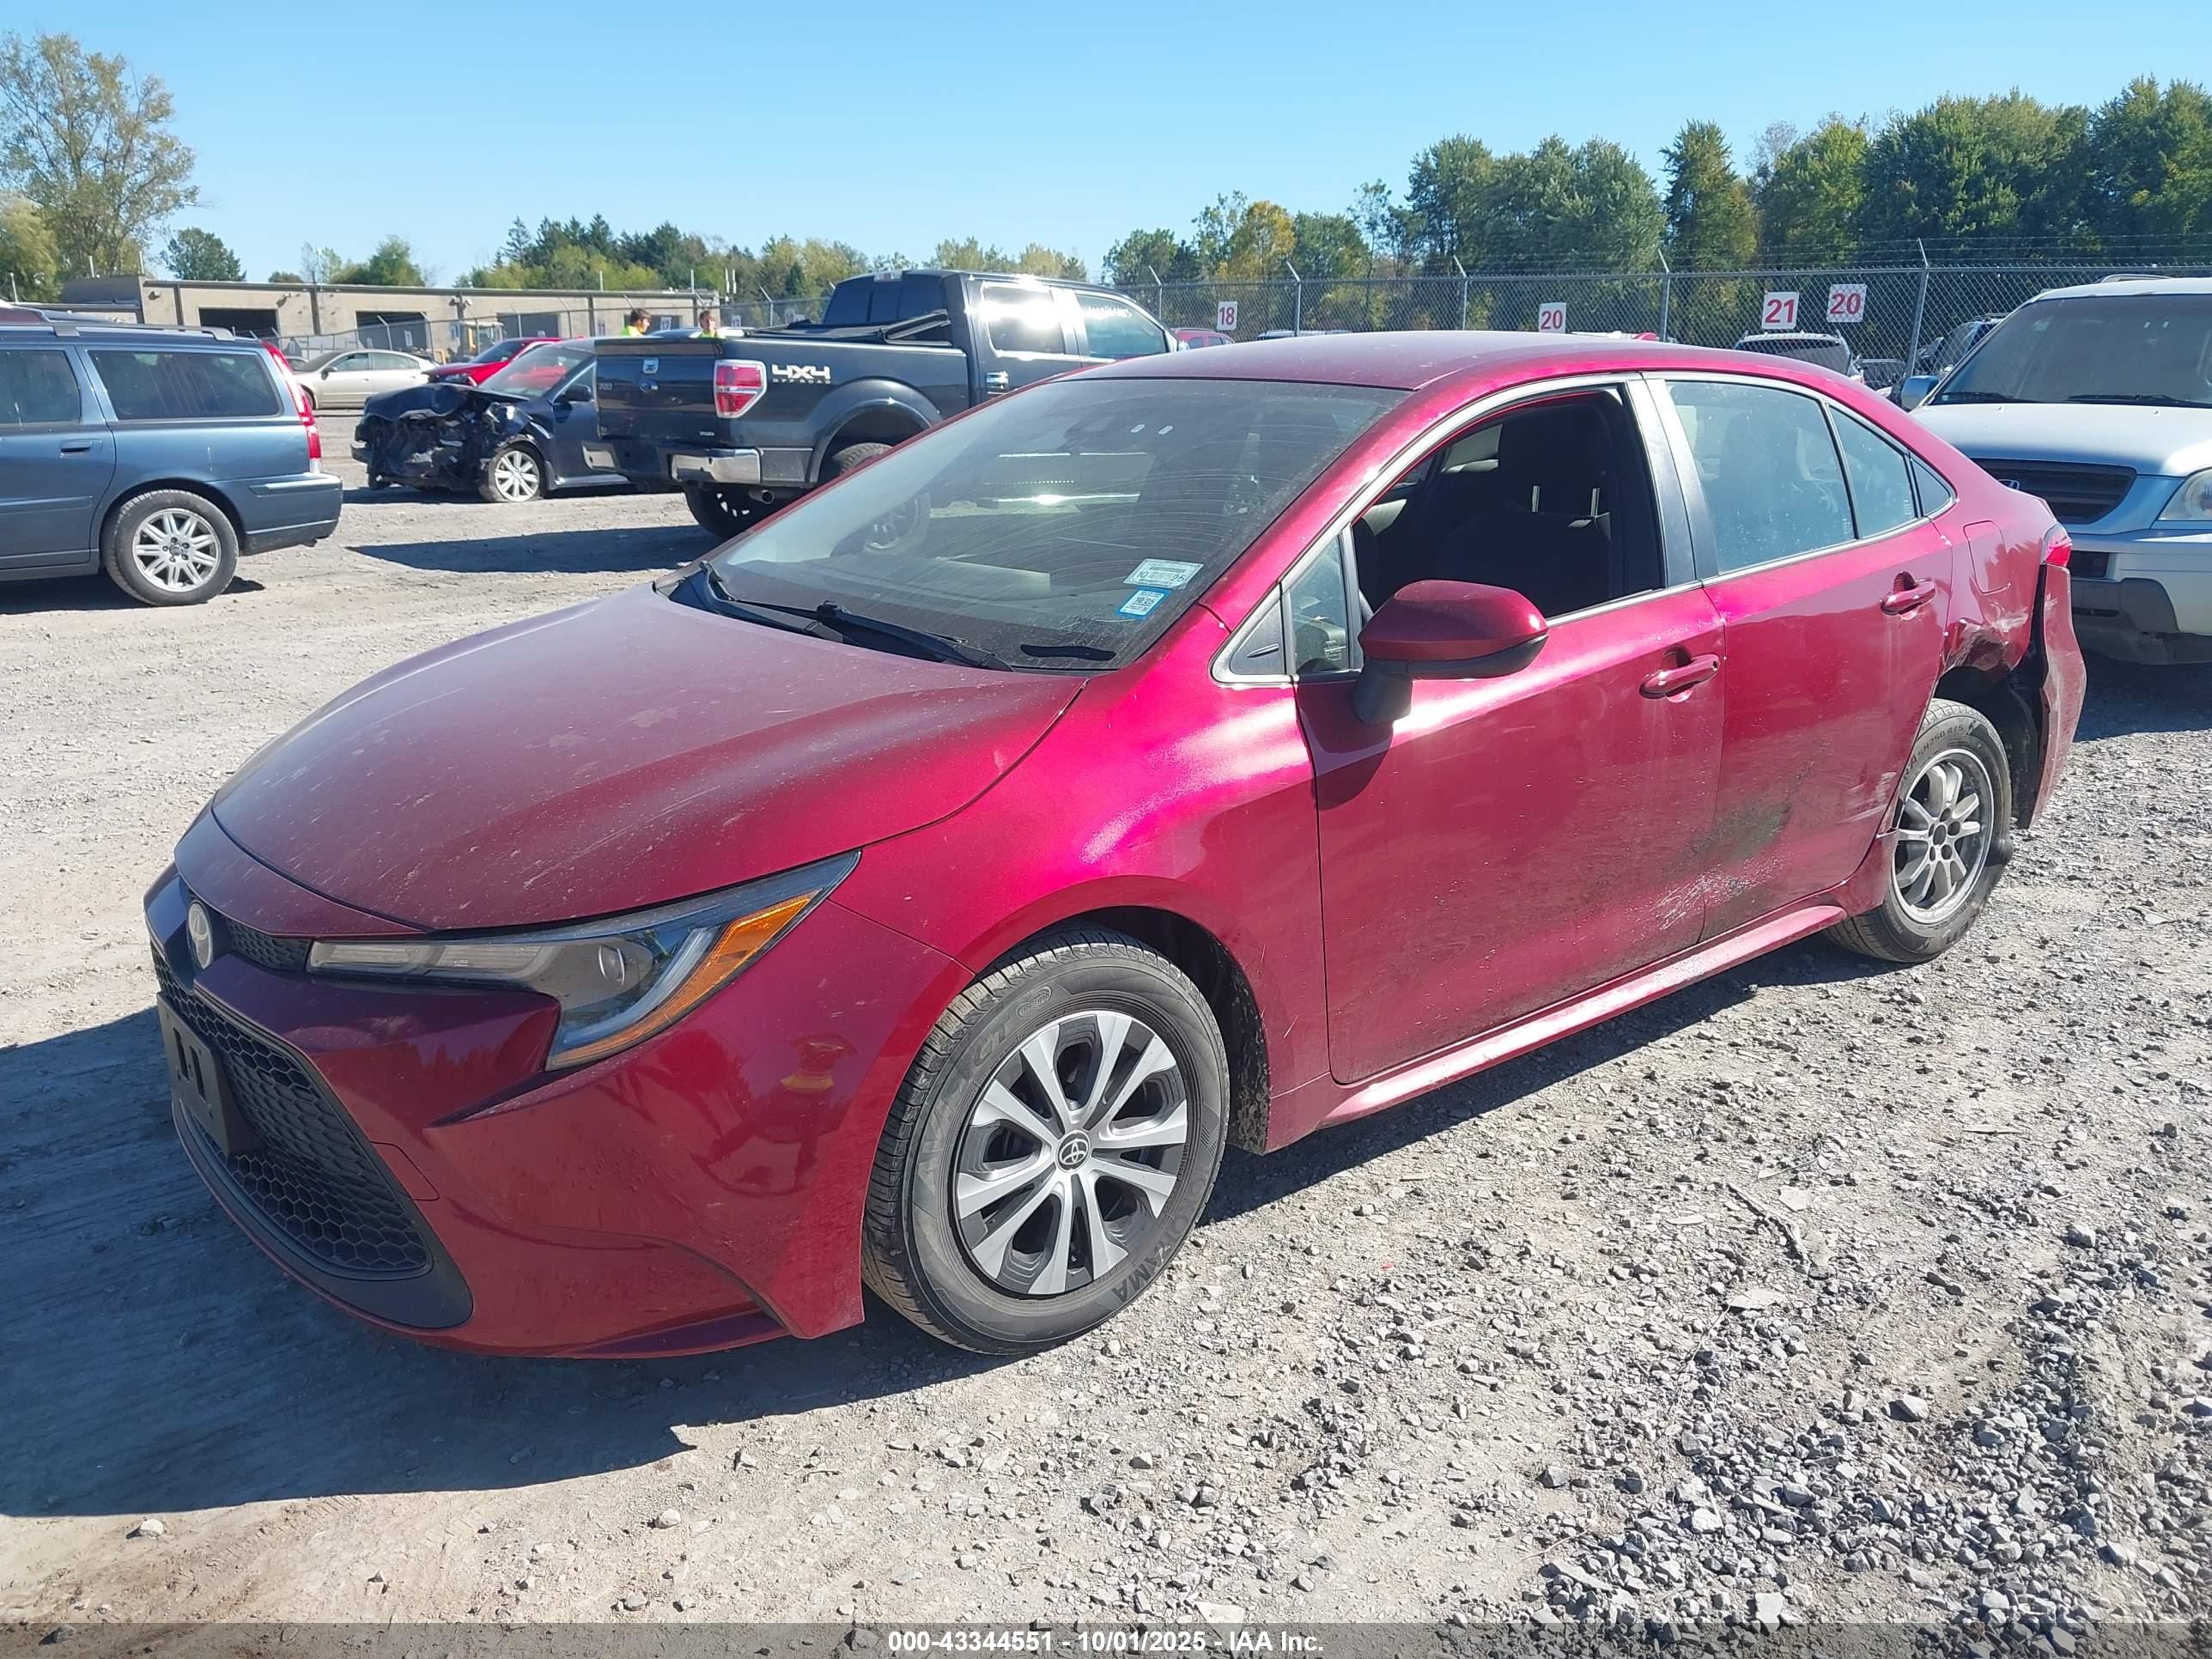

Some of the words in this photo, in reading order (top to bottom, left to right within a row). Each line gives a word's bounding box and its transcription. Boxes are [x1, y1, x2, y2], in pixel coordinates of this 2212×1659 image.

[1765, 299, 1795, 323] 21
[1830, 293, 1861, 314] 20
[1219, 307, 1234, 325] 18
[1541, 310, 1563, 330] 20
